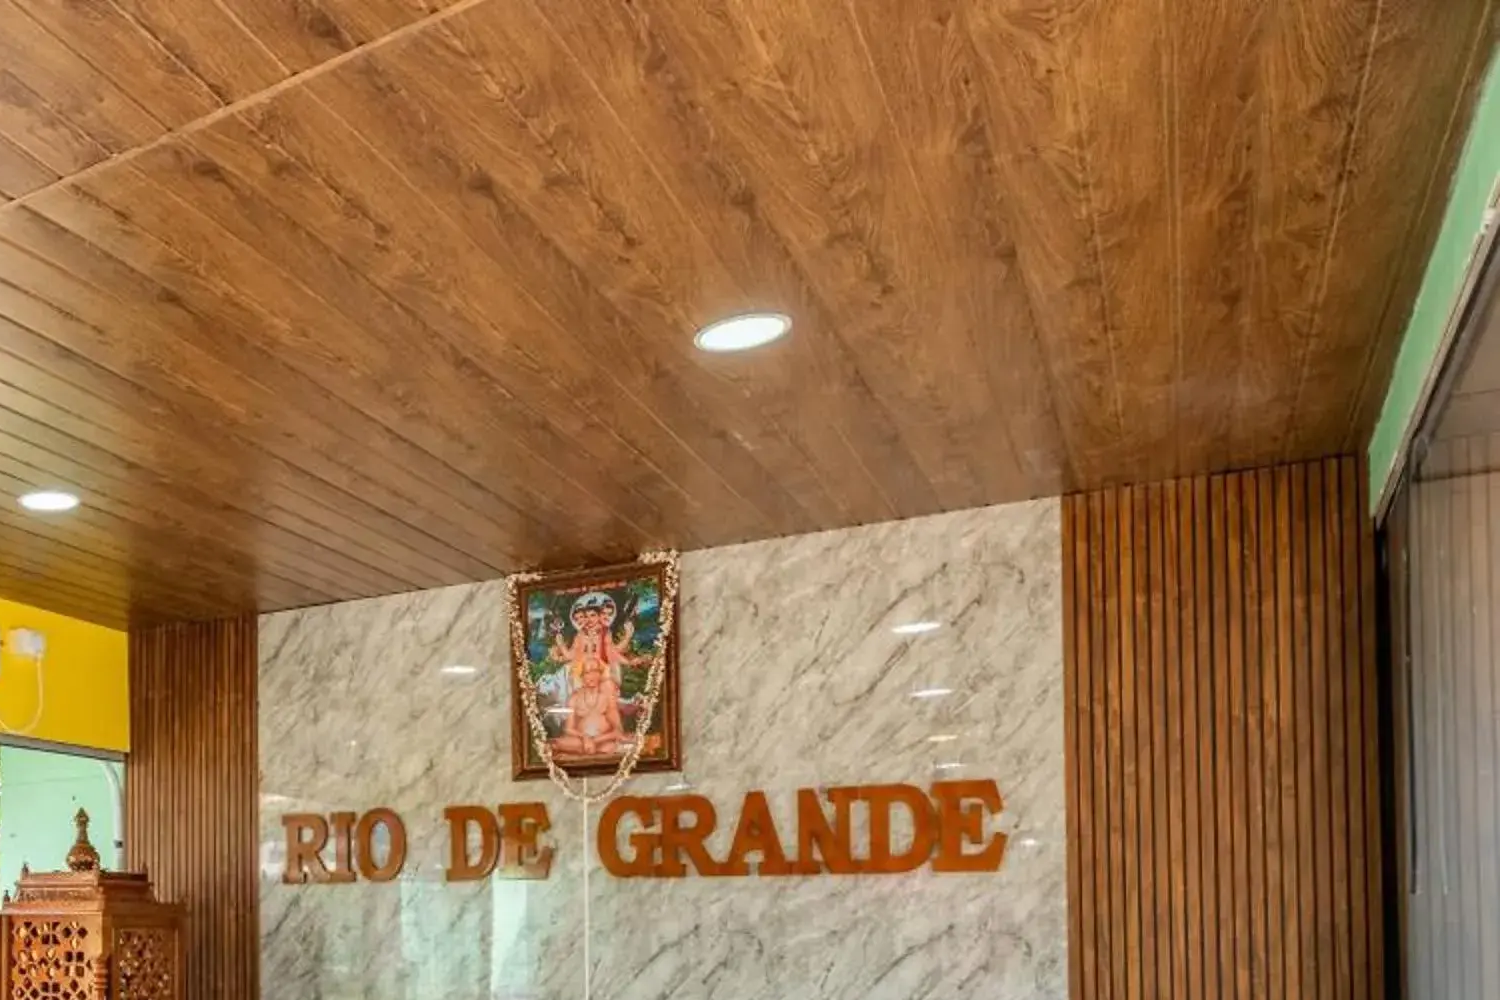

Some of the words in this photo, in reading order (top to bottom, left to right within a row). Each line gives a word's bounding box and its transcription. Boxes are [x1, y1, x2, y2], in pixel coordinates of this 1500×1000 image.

[282, 807, 406, 884] RIO
[444, 802, 556, 882] DE
[596, 779, 1008, 877] GRANDE
